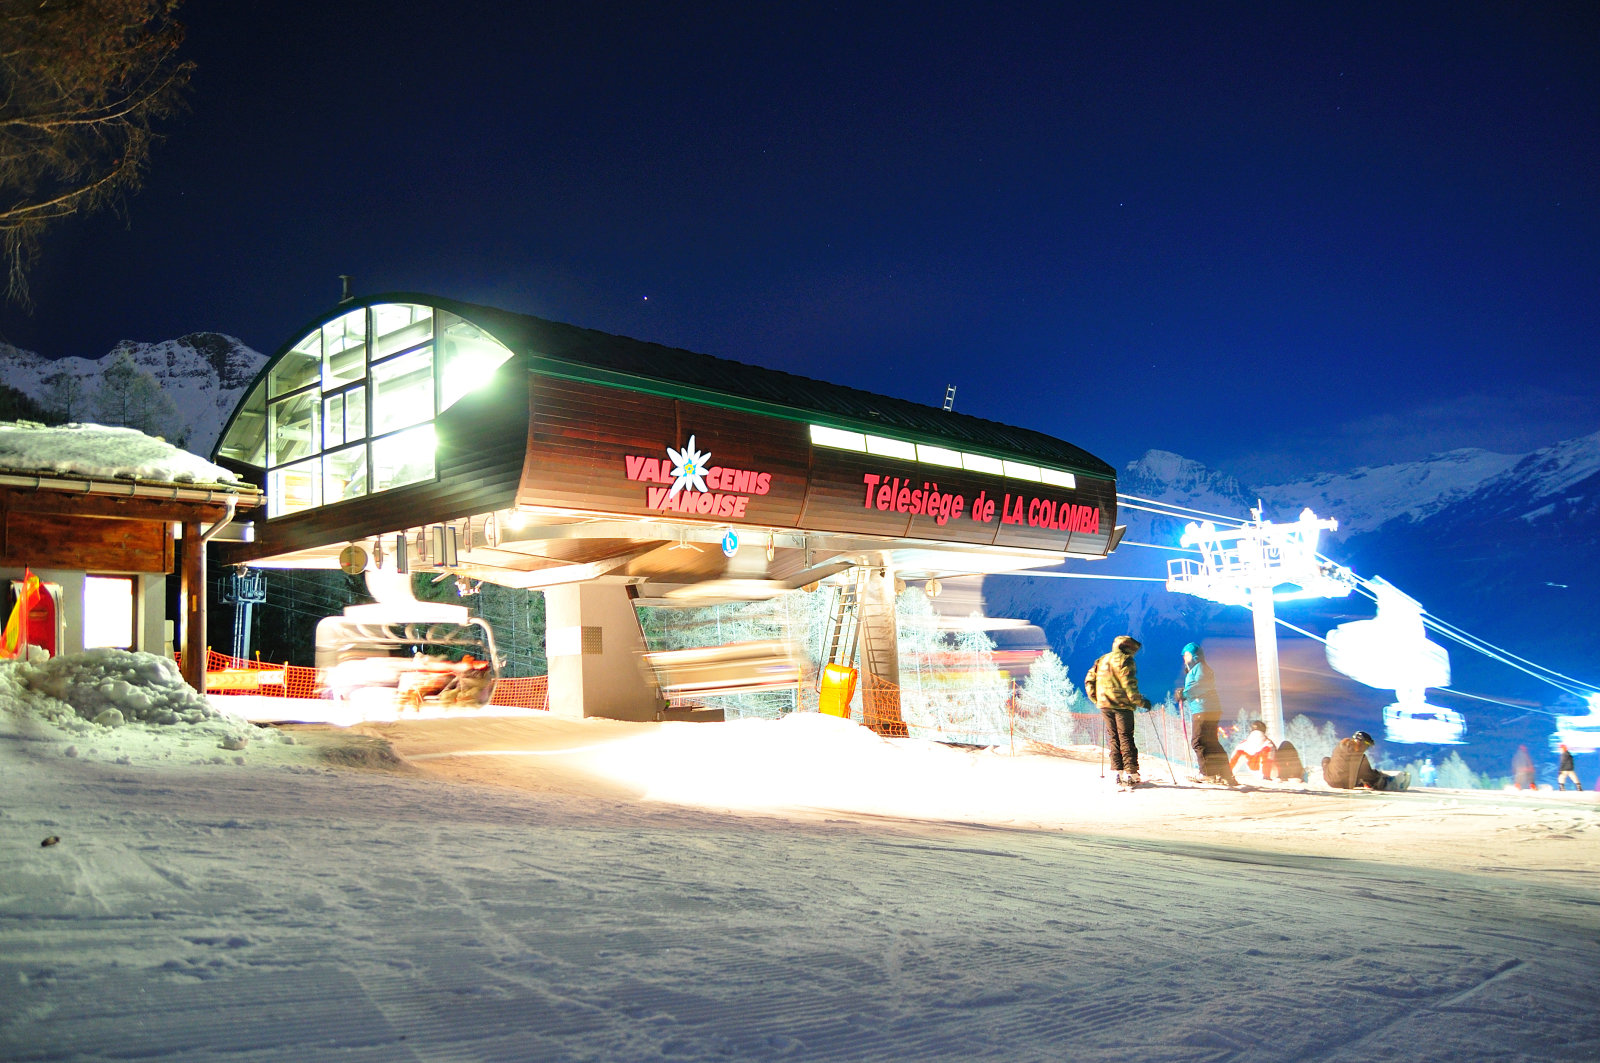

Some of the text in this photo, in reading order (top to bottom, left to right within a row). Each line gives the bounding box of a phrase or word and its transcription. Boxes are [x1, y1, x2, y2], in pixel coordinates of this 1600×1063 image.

[625, 455, 772, 495] VAL CENIS
[648, 487, 749, 518] VANOISE
[863, 473, 1100, 535] Télésiège de LA COLOMBA
